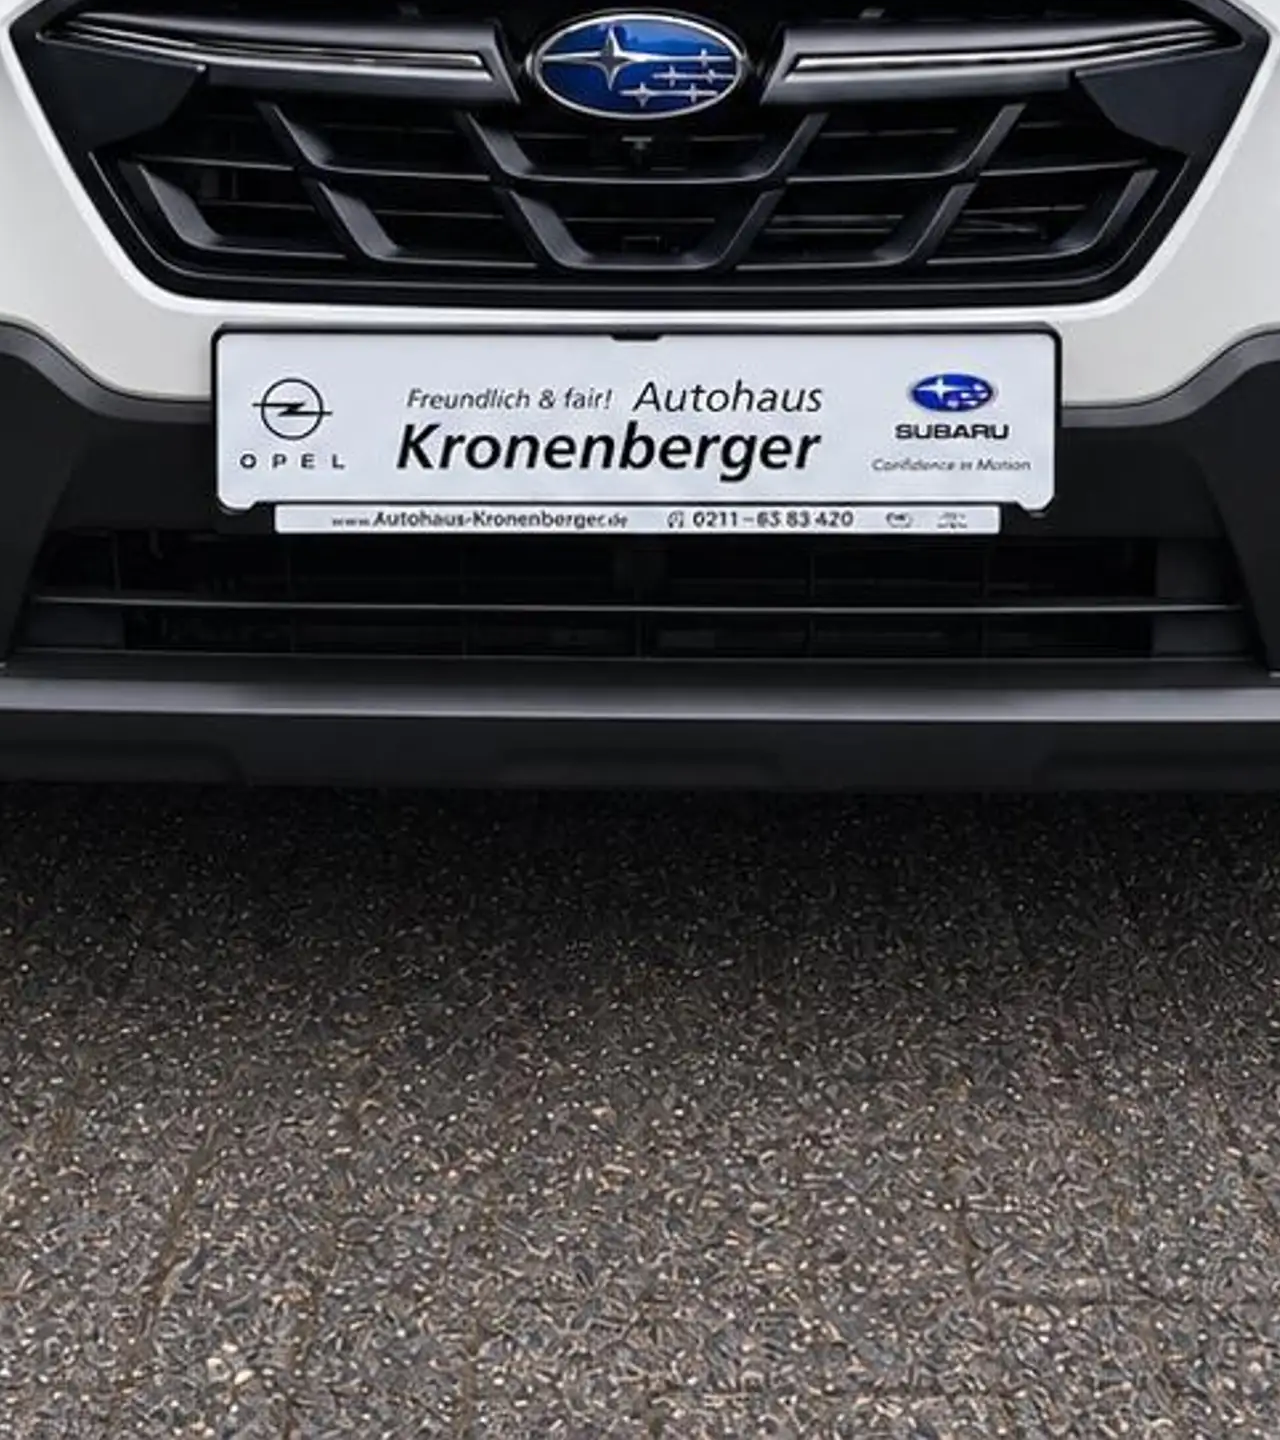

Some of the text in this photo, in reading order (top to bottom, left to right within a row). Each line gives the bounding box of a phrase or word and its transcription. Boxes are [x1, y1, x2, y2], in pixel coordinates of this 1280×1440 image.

[407, 378, 823, 412] Freundlich & fair! Autohaus
[894, 423, 1010, 440] SUBARU
[395, 419, 823, 483] Kronenberger
[239, 453, 346, 470] OPEL
[976, 457, 1032, 471] Motion
